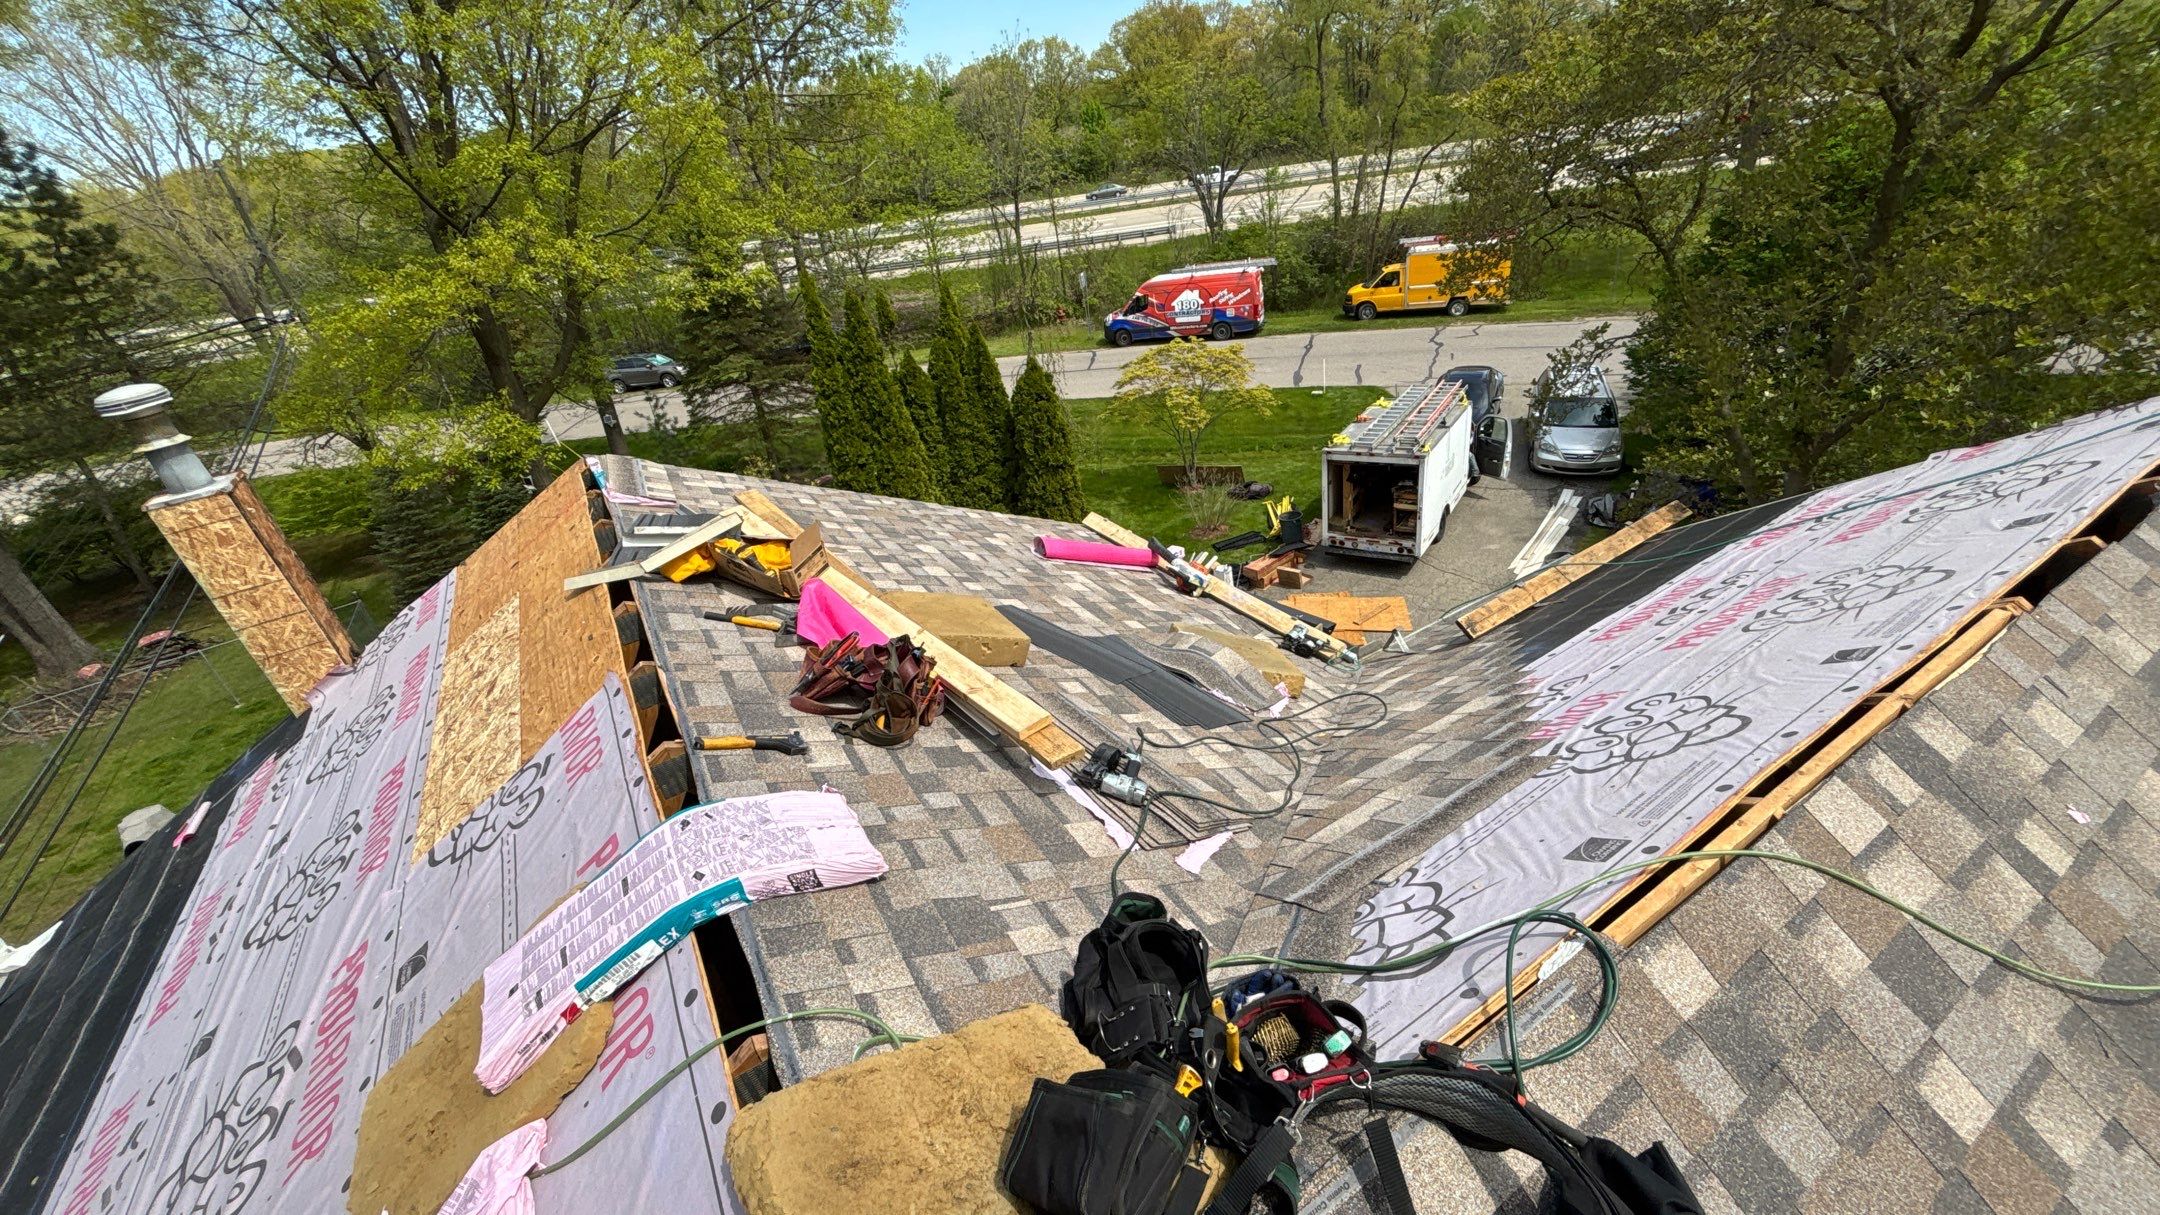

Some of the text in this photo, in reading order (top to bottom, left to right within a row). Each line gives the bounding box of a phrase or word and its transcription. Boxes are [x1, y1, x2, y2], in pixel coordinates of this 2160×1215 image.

[1166, 309, 1211, 318] CONTRACTORS
[1176, 298, 1199, 311] 180
[559, 703, 604, 793] RMOR
[353, 755, 407, 891] PROARMOR
[283, 939, 369, 1188] PROARMOR
[1326, 1180, 1351, 1203] Owens
